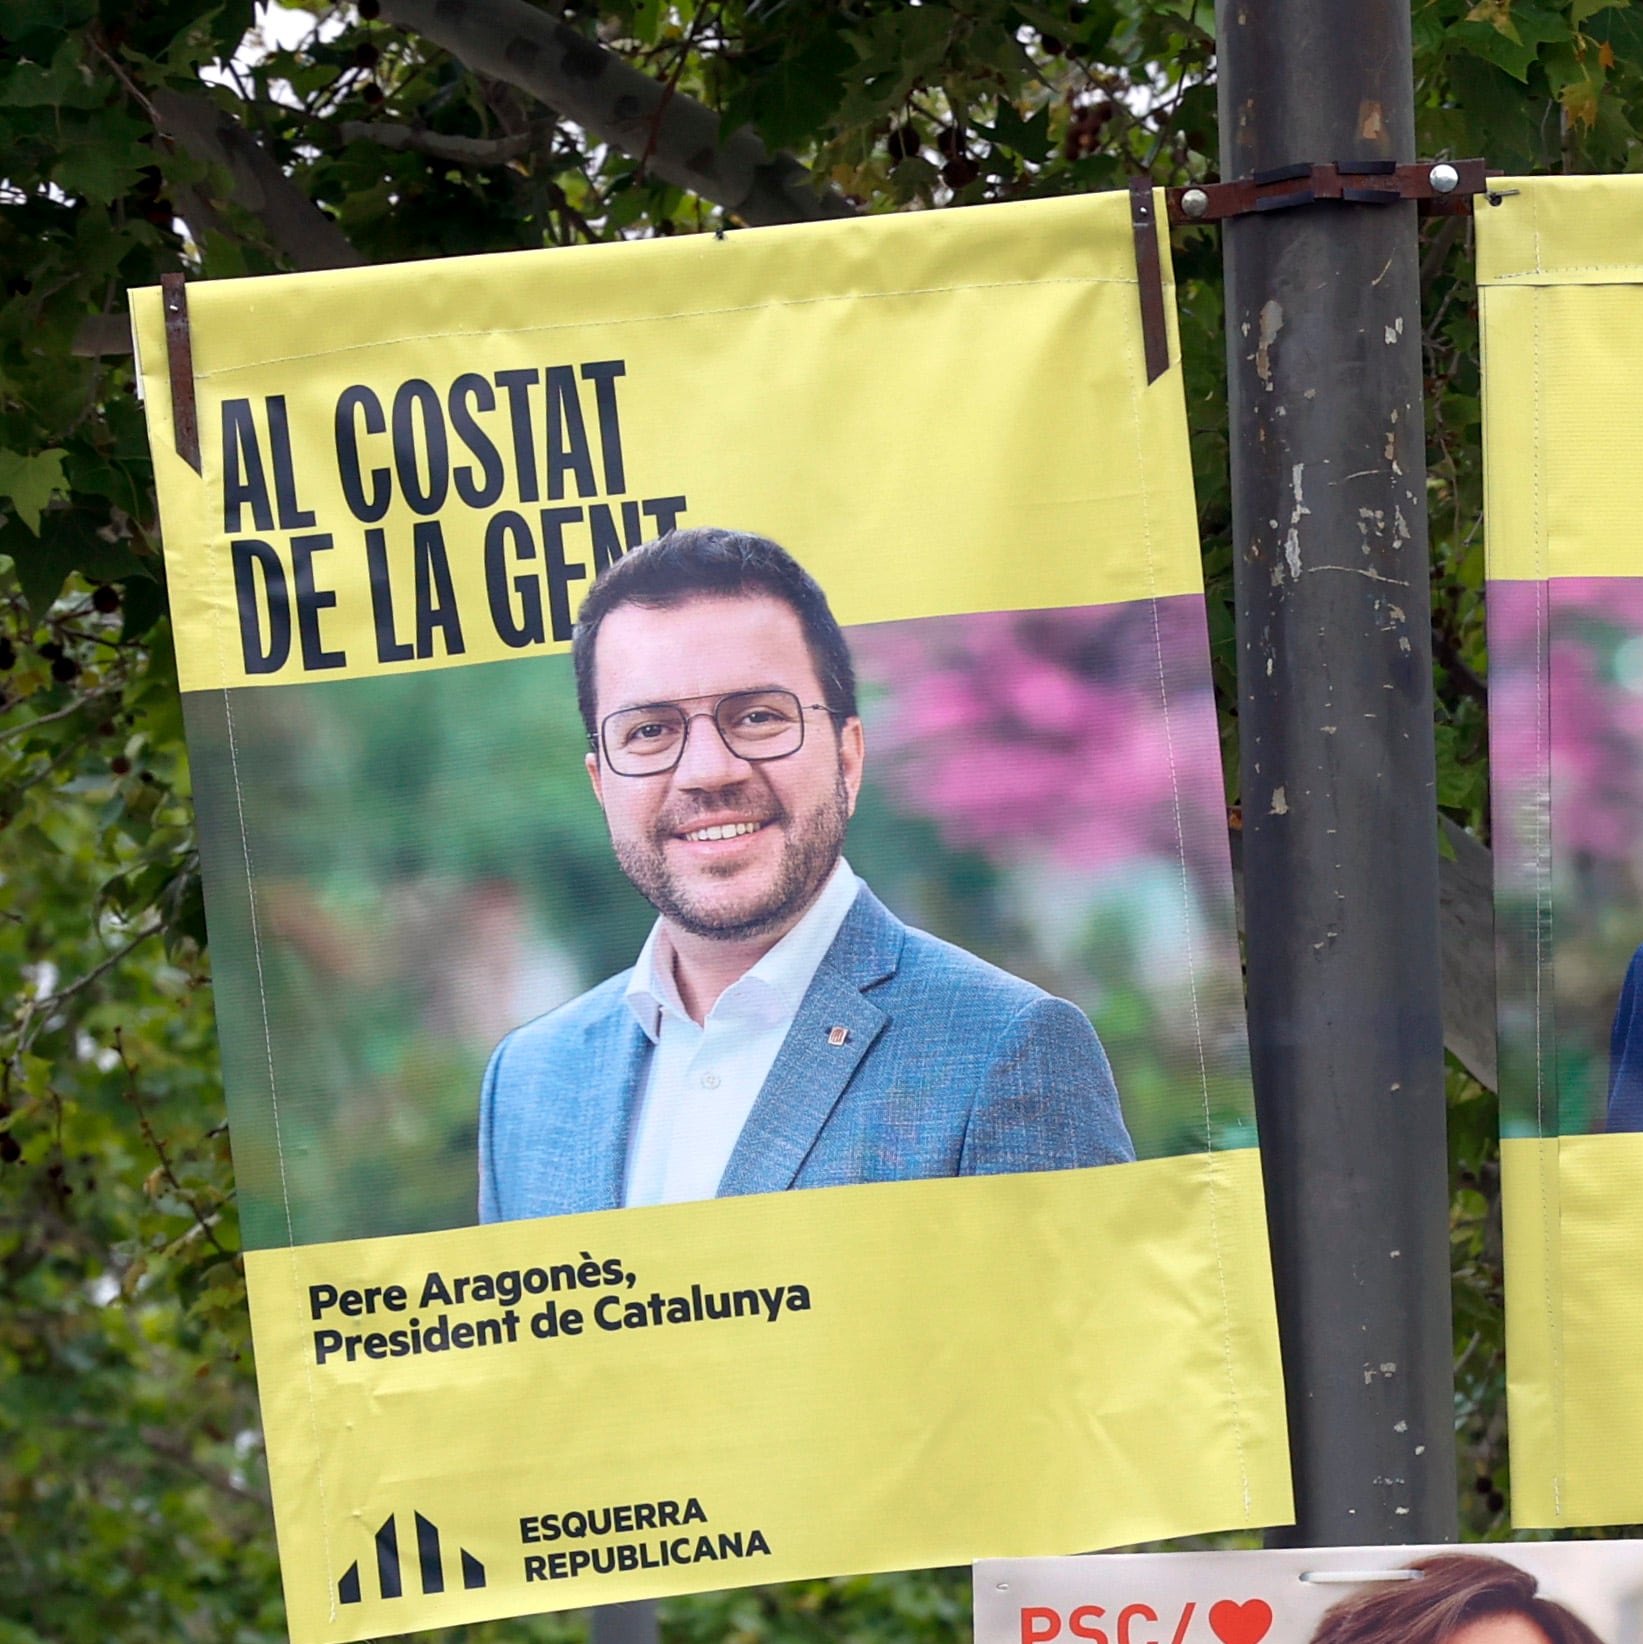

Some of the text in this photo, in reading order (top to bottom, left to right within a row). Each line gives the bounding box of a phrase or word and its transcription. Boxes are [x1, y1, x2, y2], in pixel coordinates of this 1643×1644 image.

[221, 360, 627, 533] AL COSTAT
[231, 533, 347, 675] DE
[368, 520, 465, 663] LA
[309, 1252, 637, 1320] Pere Aragonès,
[314, 1284, 811, 1365] President de Catalunya
[520, 1498, 708, 1544] ESQUERRA
[524, 1530, 772, 1582] REPUBLICANA
